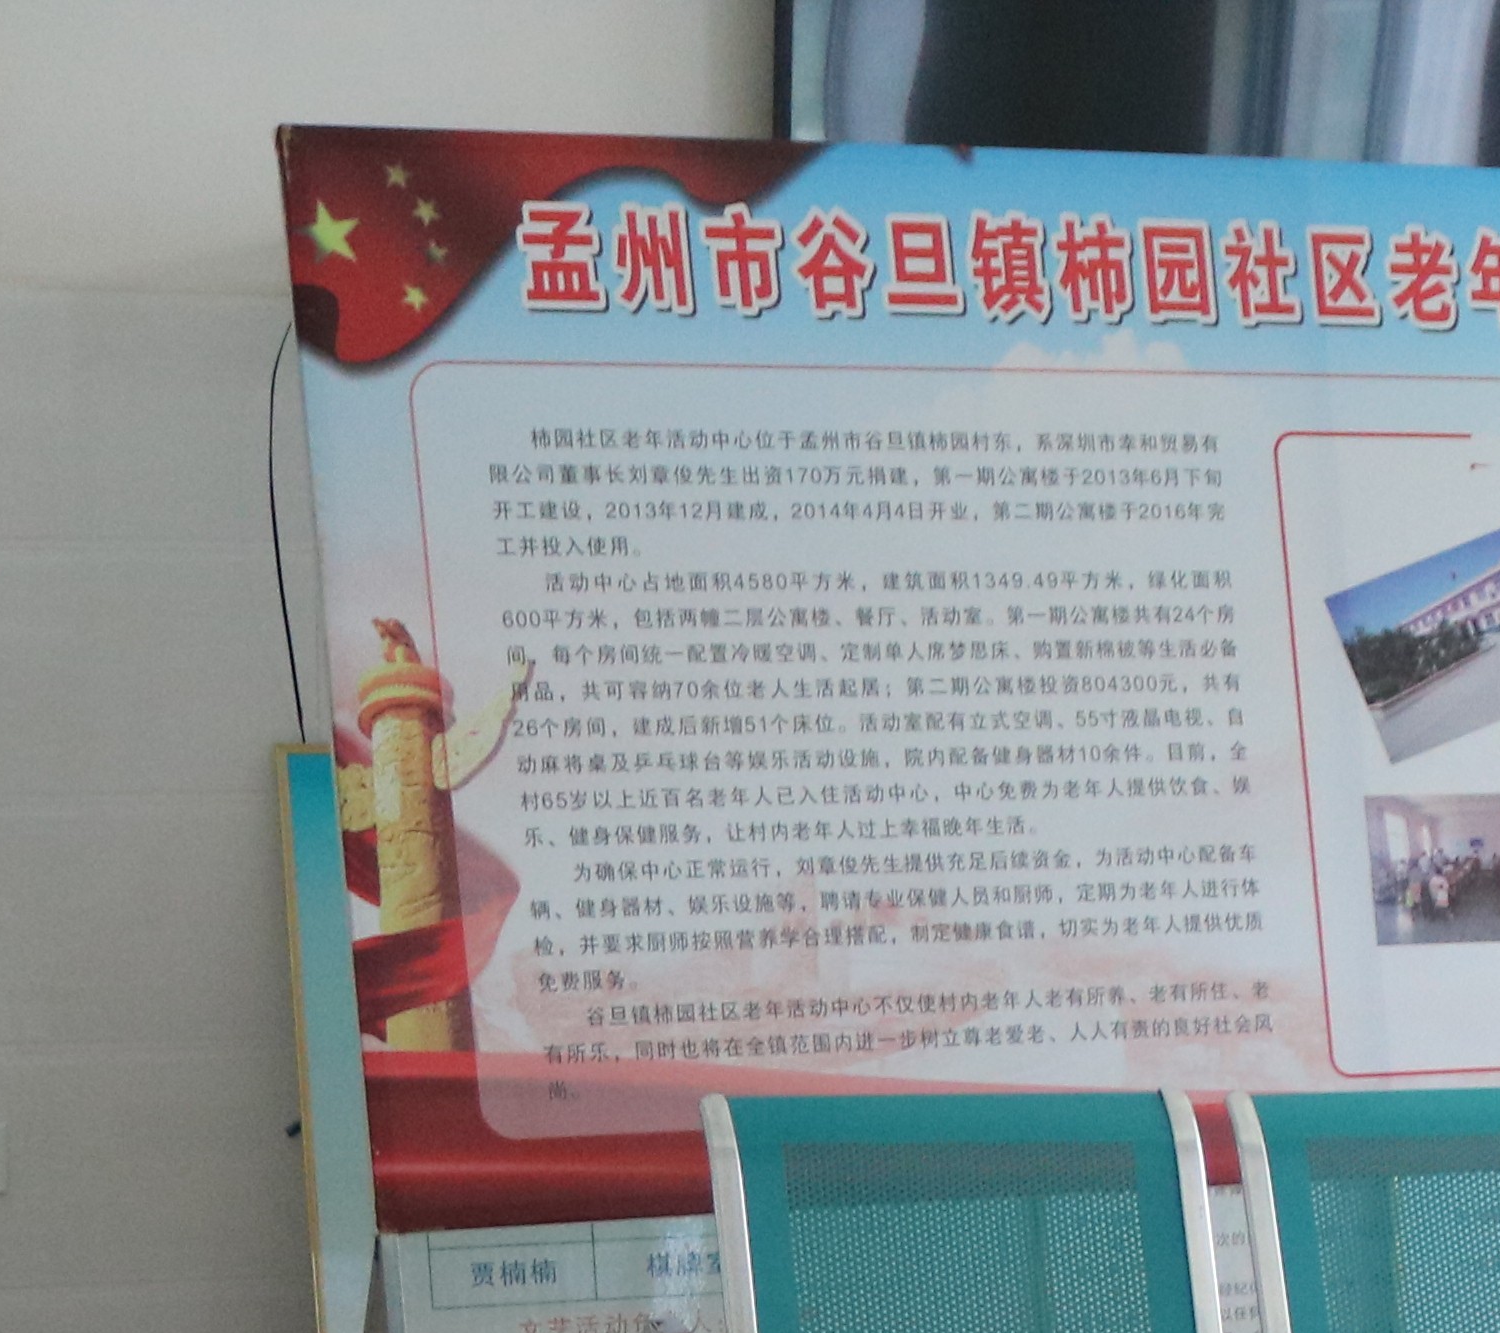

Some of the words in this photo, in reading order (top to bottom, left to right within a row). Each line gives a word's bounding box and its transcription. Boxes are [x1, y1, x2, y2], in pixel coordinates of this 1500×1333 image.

[497, 536, 640, 557] 工并投入使用。
[538, 969, 637, 993] 免费服务。
[470, 1257, 558, 1287] 贾楠楠
